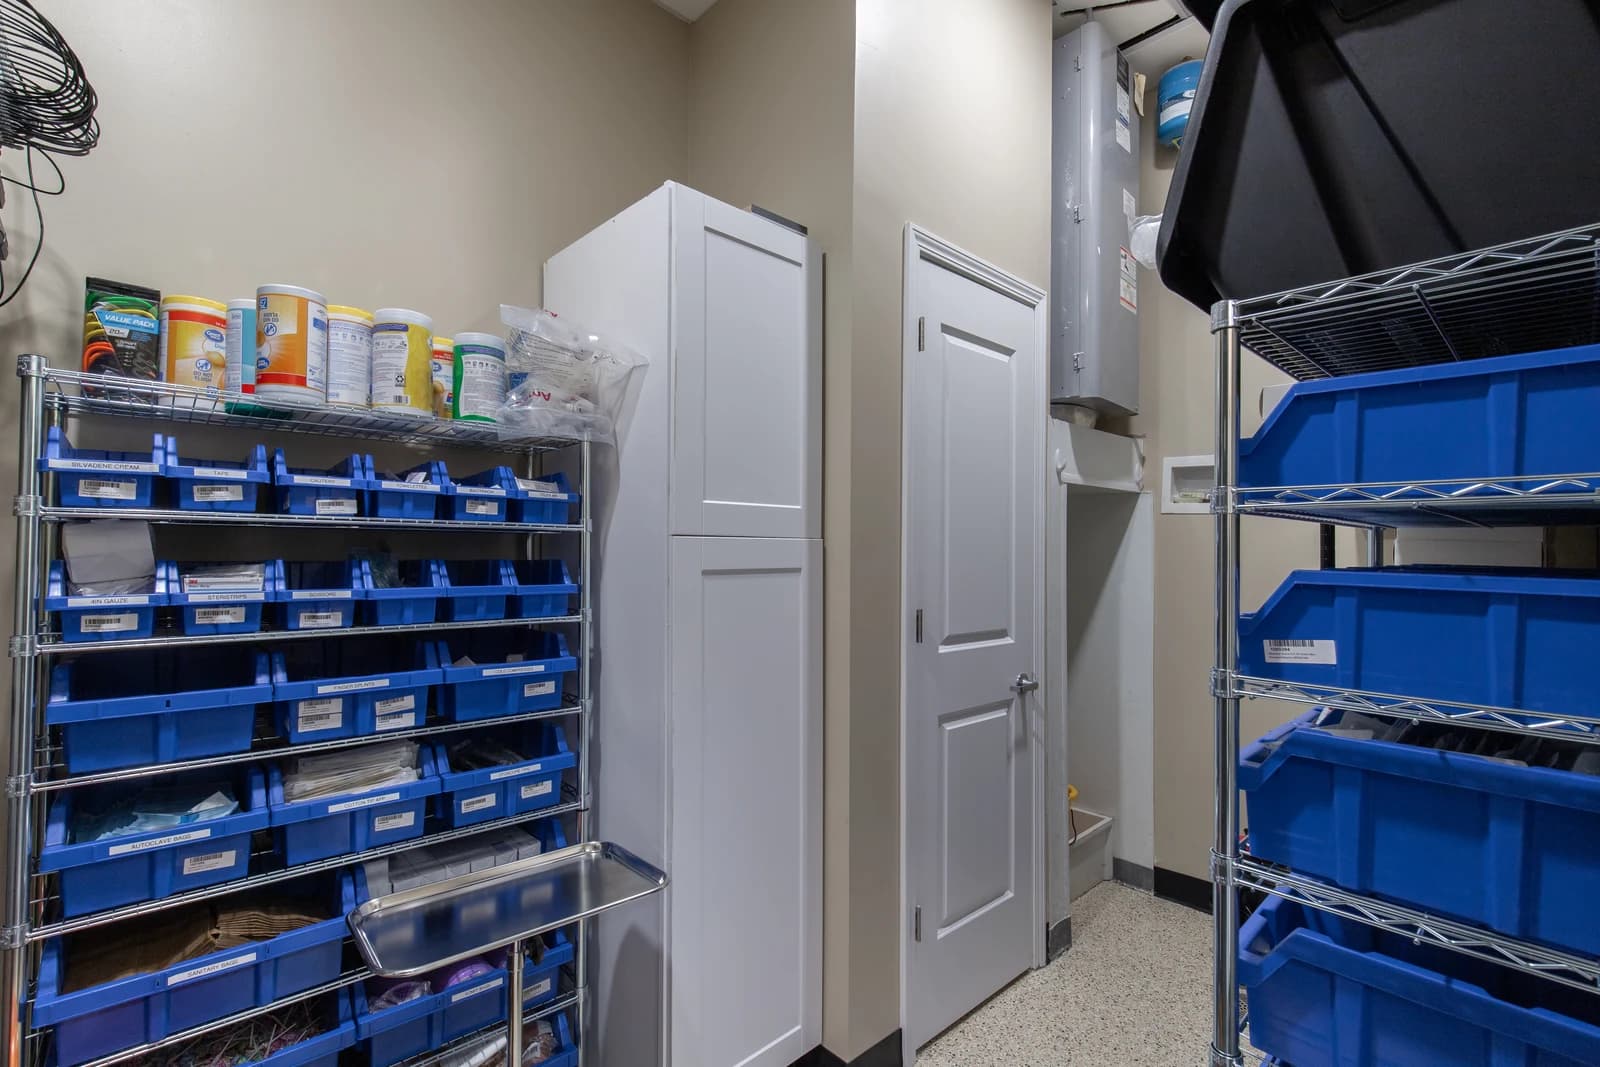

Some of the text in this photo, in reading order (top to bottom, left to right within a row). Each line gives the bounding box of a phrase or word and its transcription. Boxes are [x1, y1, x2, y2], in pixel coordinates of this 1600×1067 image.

[104, 314, 155, 329] VALUE PACK
[71, 462, 140, 471] SILVADENE CREAM
[131, 834, 192, 849] AUTOCLAVE BAGS
[187, 964, 221, 978] SANITARY
